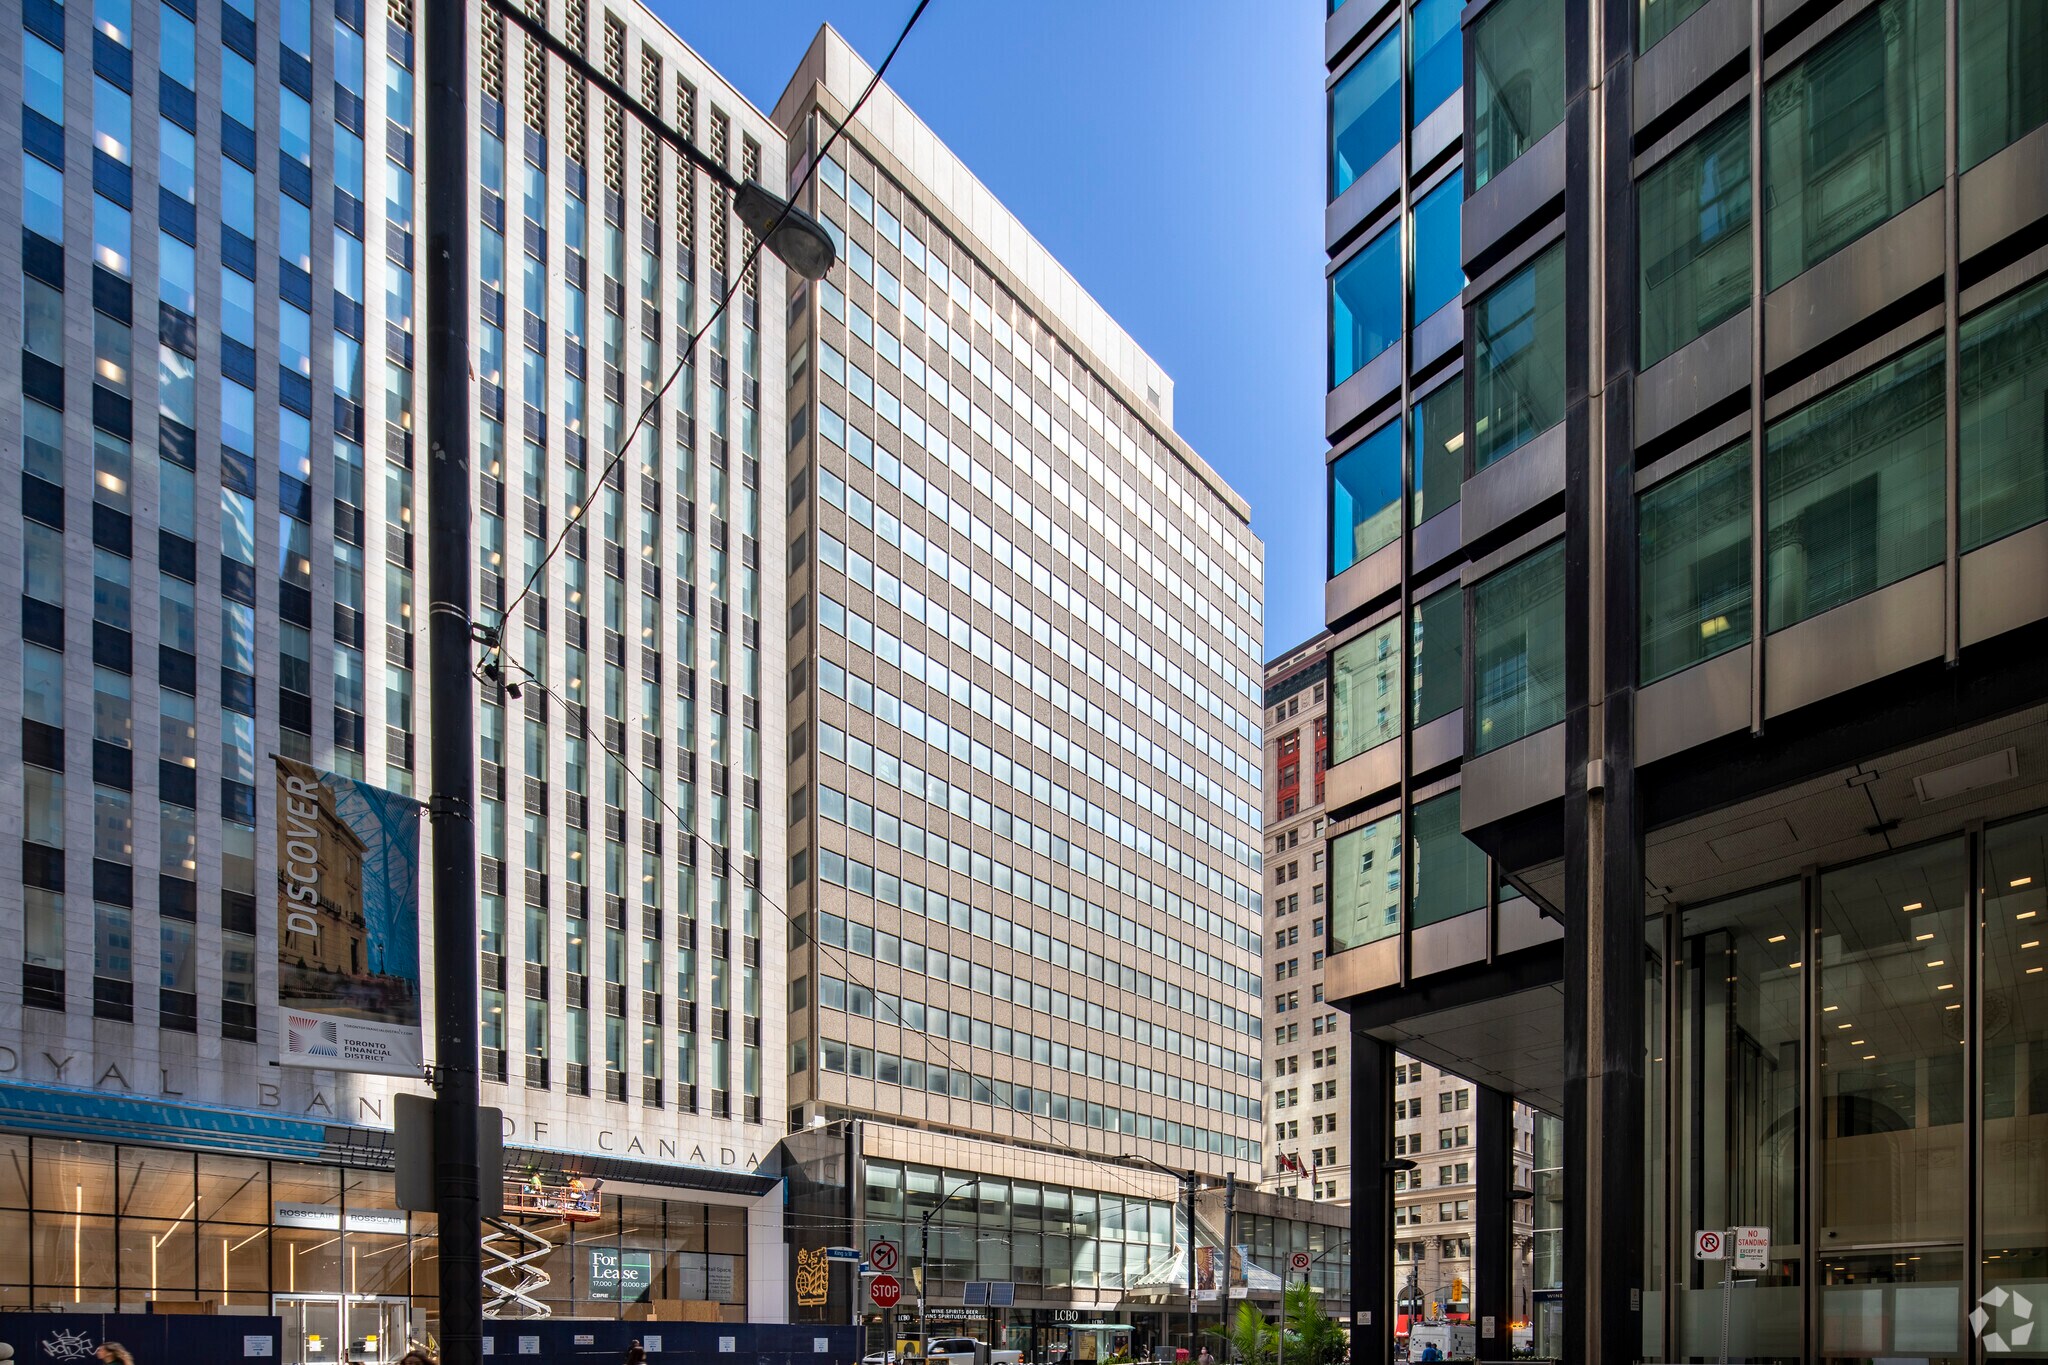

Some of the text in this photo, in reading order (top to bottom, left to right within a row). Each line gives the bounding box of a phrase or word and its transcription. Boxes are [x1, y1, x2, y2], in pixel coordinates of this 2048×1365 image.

[287, 775, 319, 937] DISCOVER
[344, 1038, 387, 1050] TORONTO
[344, 1046, 392, 1057] FINANCIAL
[344, 1053, 385, 1062] DISTRICT
[0, 1046, 183, 1096] OYAL
[257, 1082, 382, 1121] BAN
[598, 1130, 760, 1170] CANADA
[280, 1209, 334, 1219] ROSSCLAIR
[350, 1214, 402, 1224] ROSSCLAIR
[1747, 1230, 1759, 1238] NO
[1738, 1238, 1768, 1247] STANDING
[592, 1252, 618, 1266] For
[592, 1265, 639, 1280] Lease
[872, 1284, 899, 1298] STOP
[1054, 1309, 1079, 1322] LCBO
